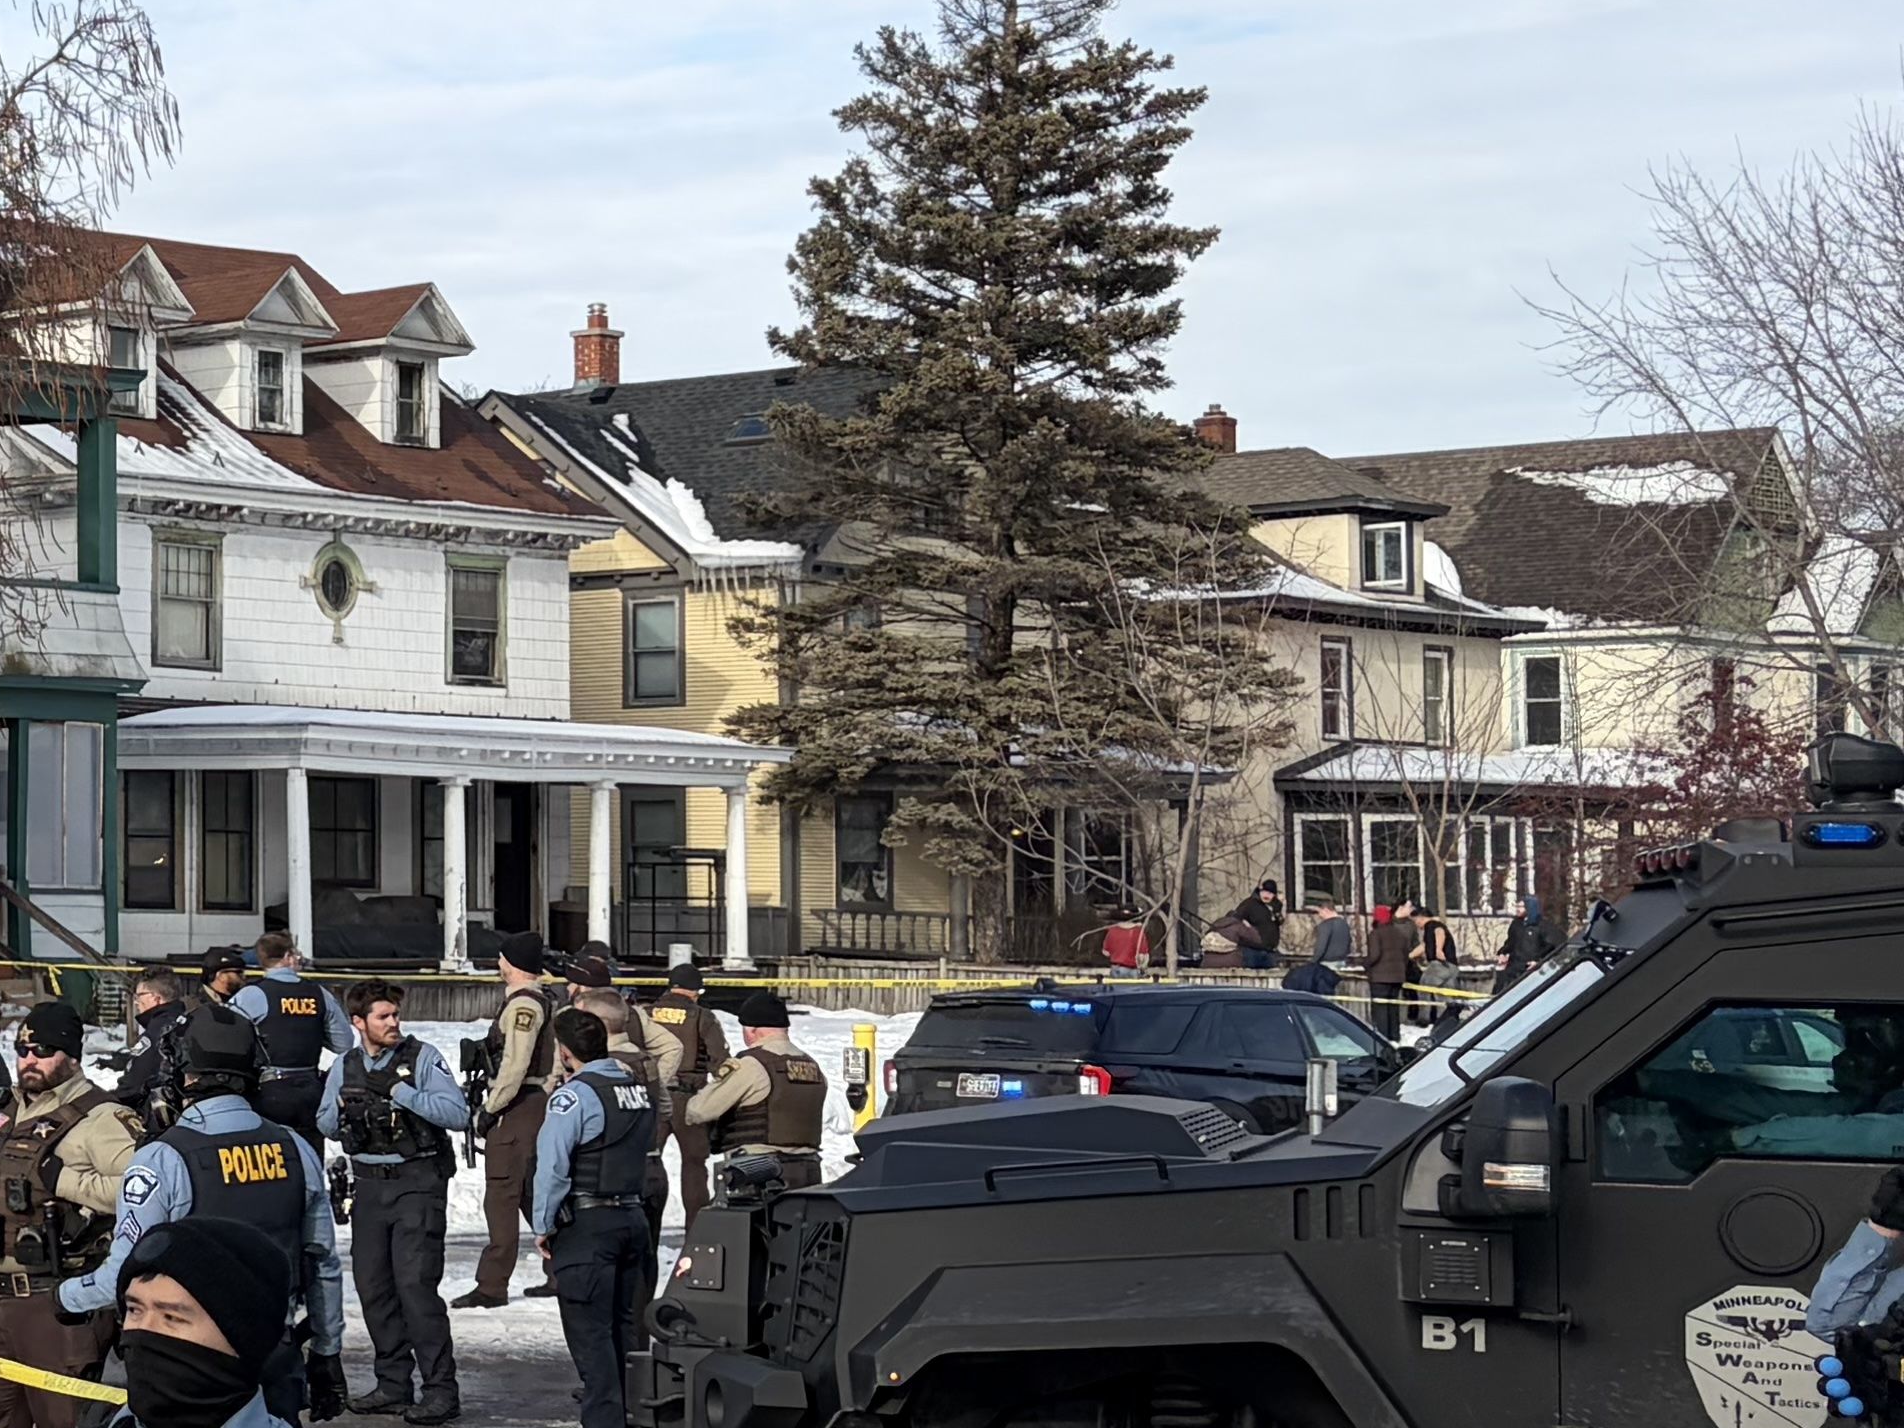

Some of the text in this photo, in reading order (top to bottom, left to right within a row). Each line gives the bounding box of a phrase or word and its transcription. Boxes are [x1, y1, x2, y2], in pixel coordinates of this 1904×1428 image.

[281, 997, 317, 1015] POLICE
[218, 1142, 288, 1184] POLICE
[1713, 1294, 1809, 1314] MINNEAPOL
[1422, 1315, 1487, 1352] B1
[1695, 1331, 1762, 1351] Special
[1715, 1352, 1815, 1372] Weapons
[1741, 1371, 1783, 1387] And
[1764, 1390, 1821, 1410] Tactics
